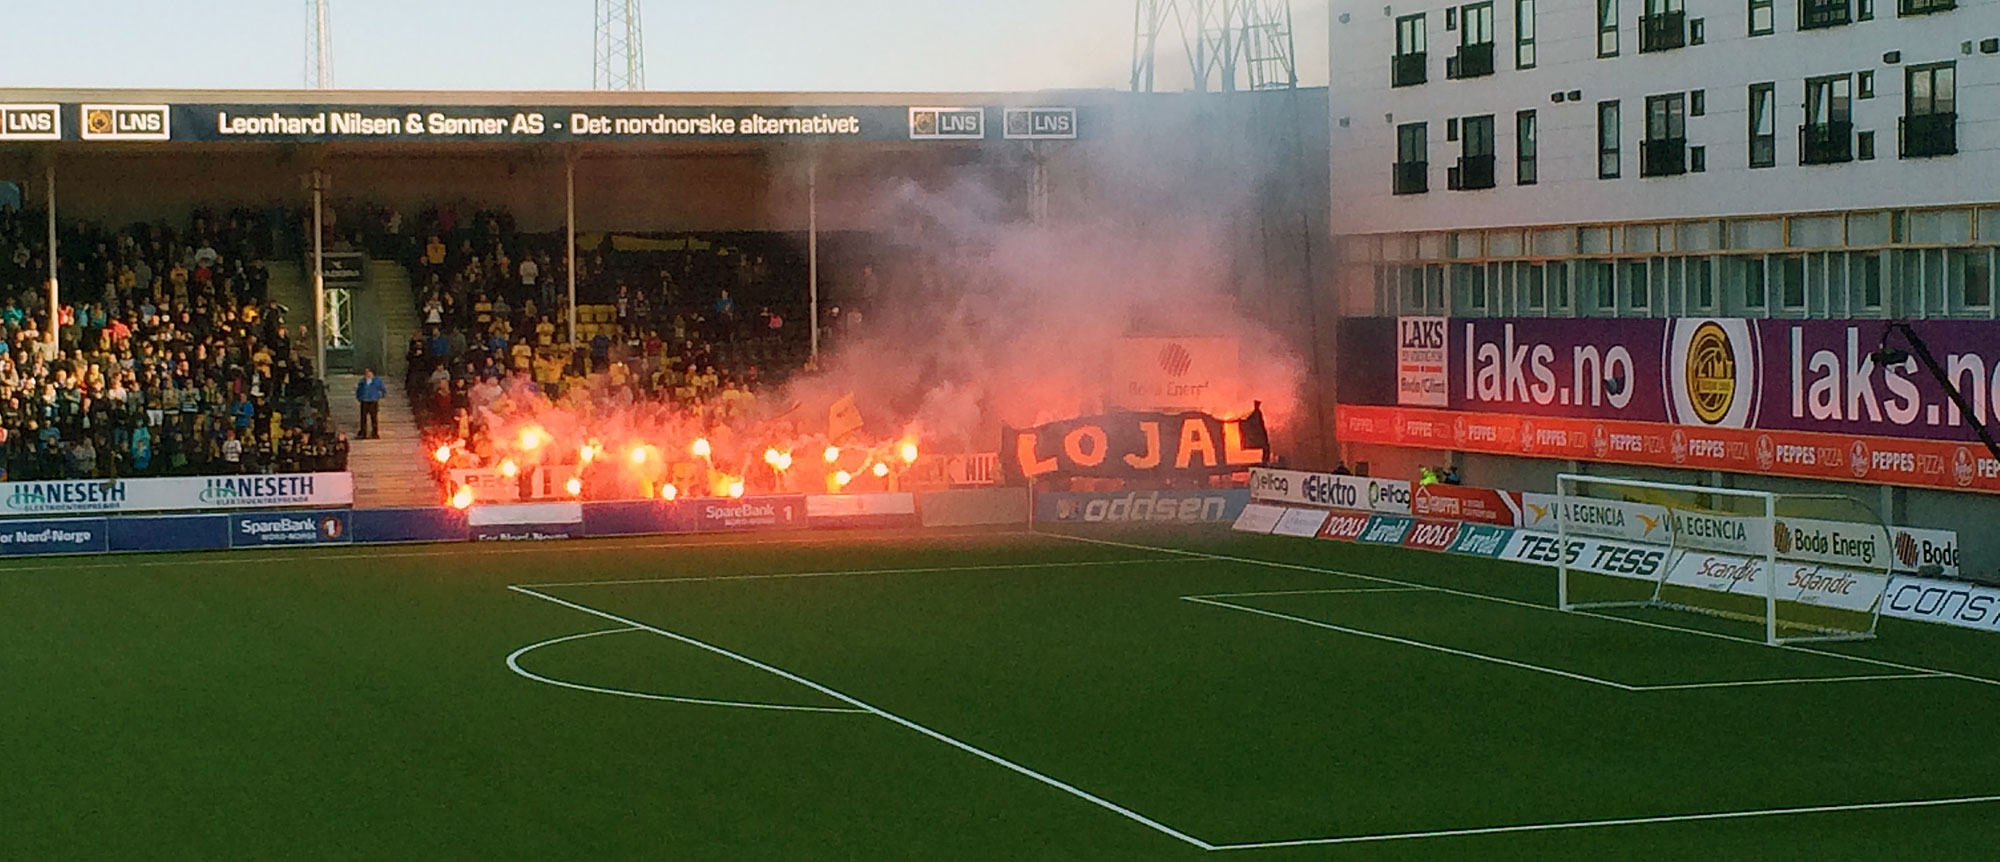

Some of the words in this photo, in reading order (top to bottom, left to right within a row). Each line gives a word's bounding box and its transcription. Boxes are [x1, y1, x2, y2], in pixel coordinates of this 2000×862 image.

[9, 112, 51, 131] LNS
[120, 112, 161, 131] LNS
[218, 112, 325, 134] Leonhard
[330, 112, 400, 134] Nilsen
[405, 112, 425, 134] &
[427, 112, 507, 135] Sønner
[511, 112, 545, 134] AS
[571, 112, 612, 134] Det
[615, 112, 735, 135] nordnorske
[739, 112, 860, 134] alternativet
[941, 115, 977, 131] LNS
[1035, 115, 1070, 131] LNS
[1402, 320, 1443, 349] LAKS
[1466, 322, 1635, 409] laks.no
[1017, 418, 1264, 478] LOJAL
[1536, 429, 1567, 447] PEPPES
[1610, 433, 1643, 452] PEPPES
[1689, 439, 1725, 458] PEPPES
[1776, 444, 1816, 464] PEPPES
[1818, 448, 1843, 467] PIZZA
[1872, 451, 1915, 472] PEPPES
[1917, 454, 1945, 474] PIZZA
[204, 476, 314, 499] HANESETH
[705, 504, 775, 519] SpareBank
[1083, 491, 1227, 523] oddsen
[1551, 503, 1571, 521] VA
[1573, 504, 1625, 527] EGENCIA
[0, 534, 14, 543] or
[16, 529, 91, 544] Nord-Norge
[241, 518, 317, 535] SpareBank
[1325, 516, 1365, 537] TOOLS
[1410, 523, 1454, 547] TOOLS
[1662, 516, 1684, 534] VA
[1687, 519, 1747, 541] EGENCIA
[1516, 535, 1586, 565] TESS
[1795, 529, 1828, 554] Bodø
[1833, 532, 1876, 564] Energi
[1591, 545, 1665, 576] TESS
[1696, 557, 1762, 583] Scandic
[1788, 567, 1858, 595] Scandic
